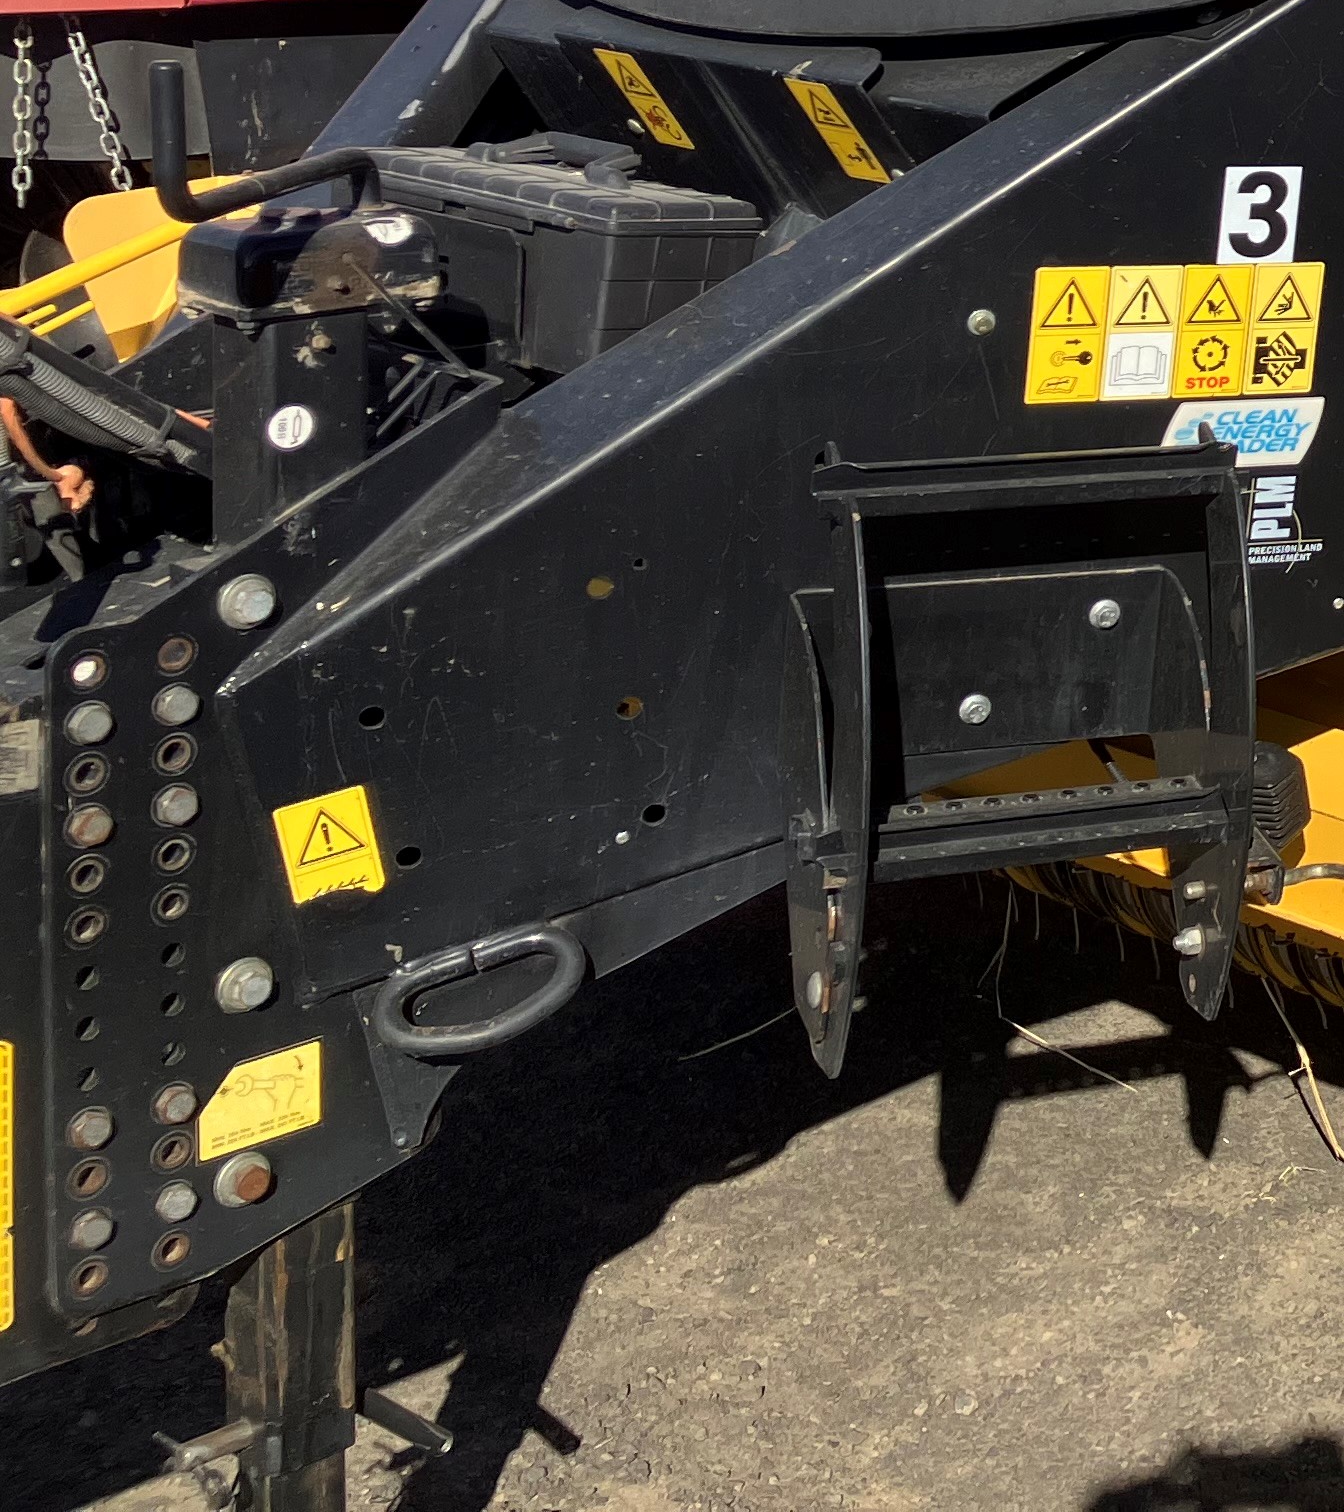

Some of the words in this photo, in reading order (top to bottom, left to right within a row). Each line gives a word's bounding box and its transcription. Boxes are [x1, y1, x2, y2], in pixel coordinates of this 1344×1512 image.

[1228, 171, 1288, 258] 3
[1185, 376, 1230, 389] STOP
[1217, 408, 1298, 426] CLEAN
[1213, 422, 1312, 439] ENERGY
[1236, 438, 1299, 453] ADER
[1249, 475, 1297, 540] PLM
[1248, 544, 1297, 556] PRECISION
[1297, 542, 1323, 553] LAND
[1247, 552, 1312, 564] MANAGEMENT
